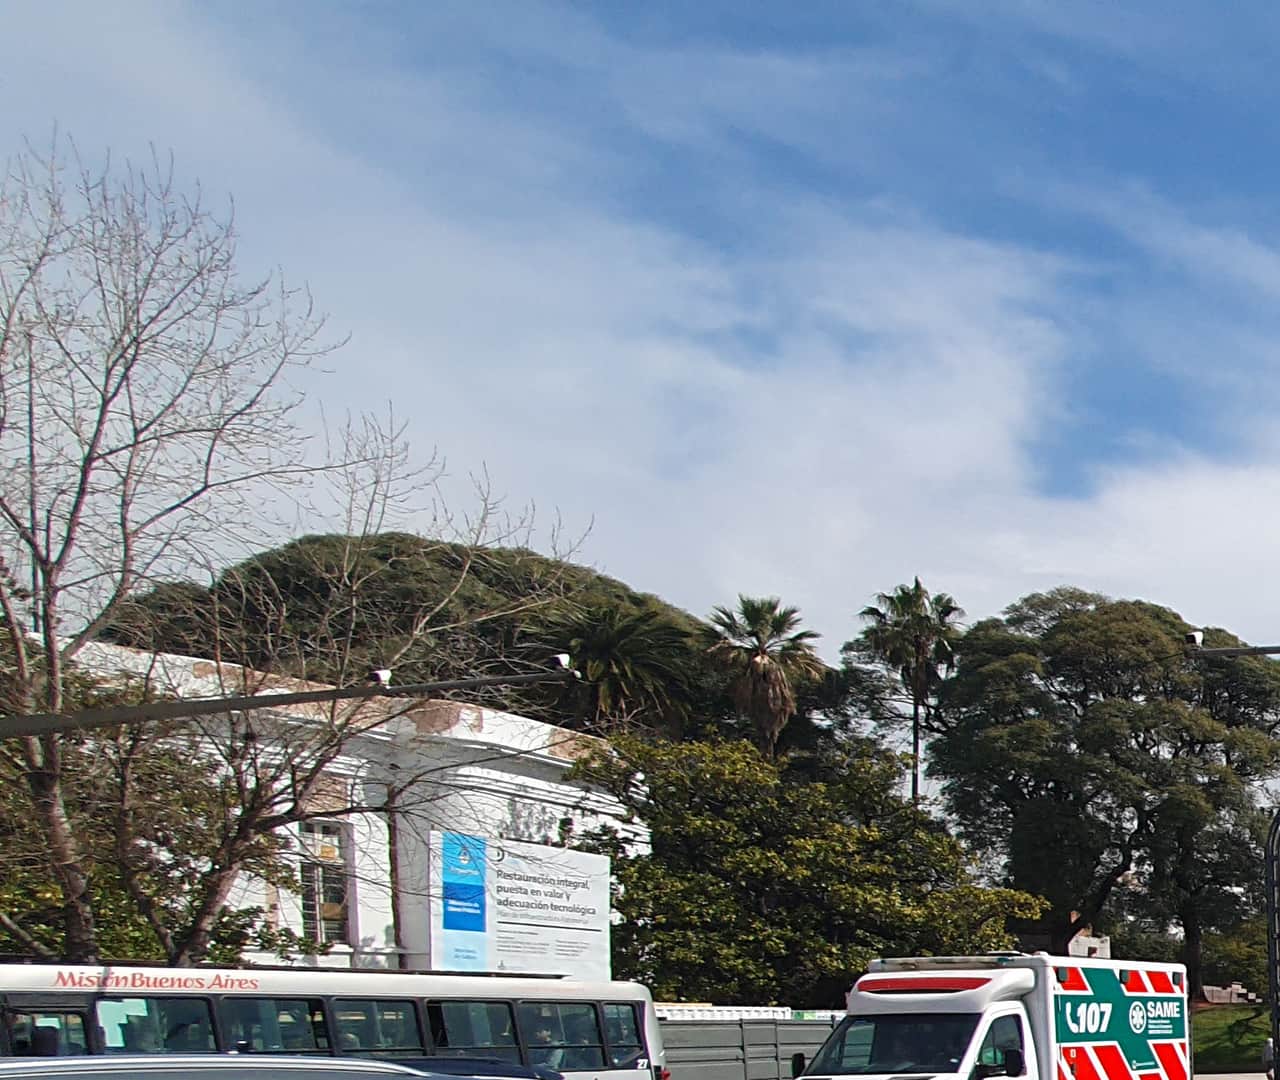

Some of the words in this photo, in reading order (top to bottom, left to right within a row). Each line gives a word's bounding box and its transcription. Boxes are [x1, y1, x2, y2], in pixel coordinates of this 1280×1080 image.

[496, 884, 529, 898] puesta
[530, 888, 542, 897] en
[543, 889, 564, 900] valor
[496, 897, 549, 911] adecuación
[549, 902, 597, 917] tecnológica
[53, 970, 129, 988] Misión
[130, 972, 205, 990] Buenos
[207, 973, 260, 990] Aires
[1076, 1001, 1113, 1034] 107
[1146, 1001, 1181, 1018] SAME
